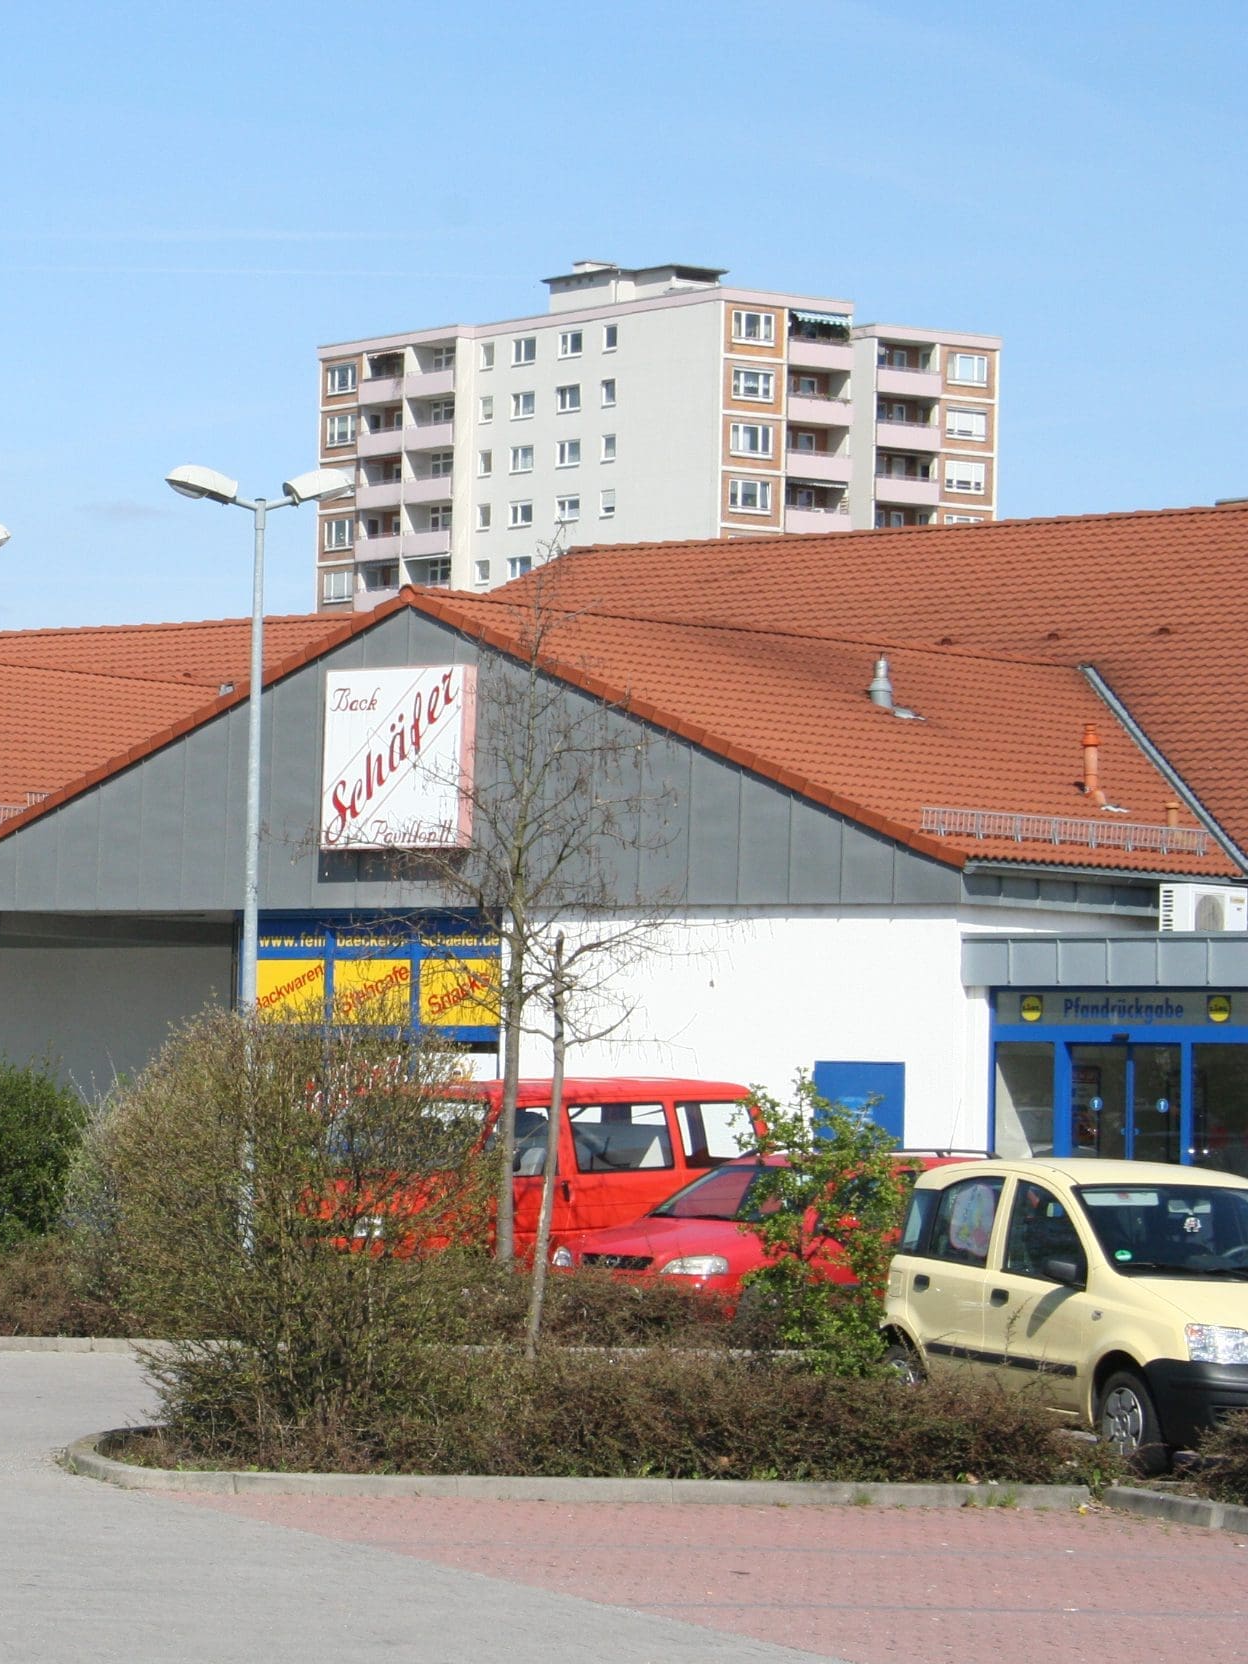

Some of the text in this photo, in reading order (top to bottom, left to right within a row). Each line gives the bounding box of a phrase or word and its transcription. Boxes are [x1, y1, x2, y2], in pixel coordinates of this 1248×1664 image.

[329, 687, 381, 711] Back
[325, 667, 459, 844] Schäfer
[428, 972, 491, 1015] Snacks
[1063, 996, 1185, 1025] Pfandrückgabe
